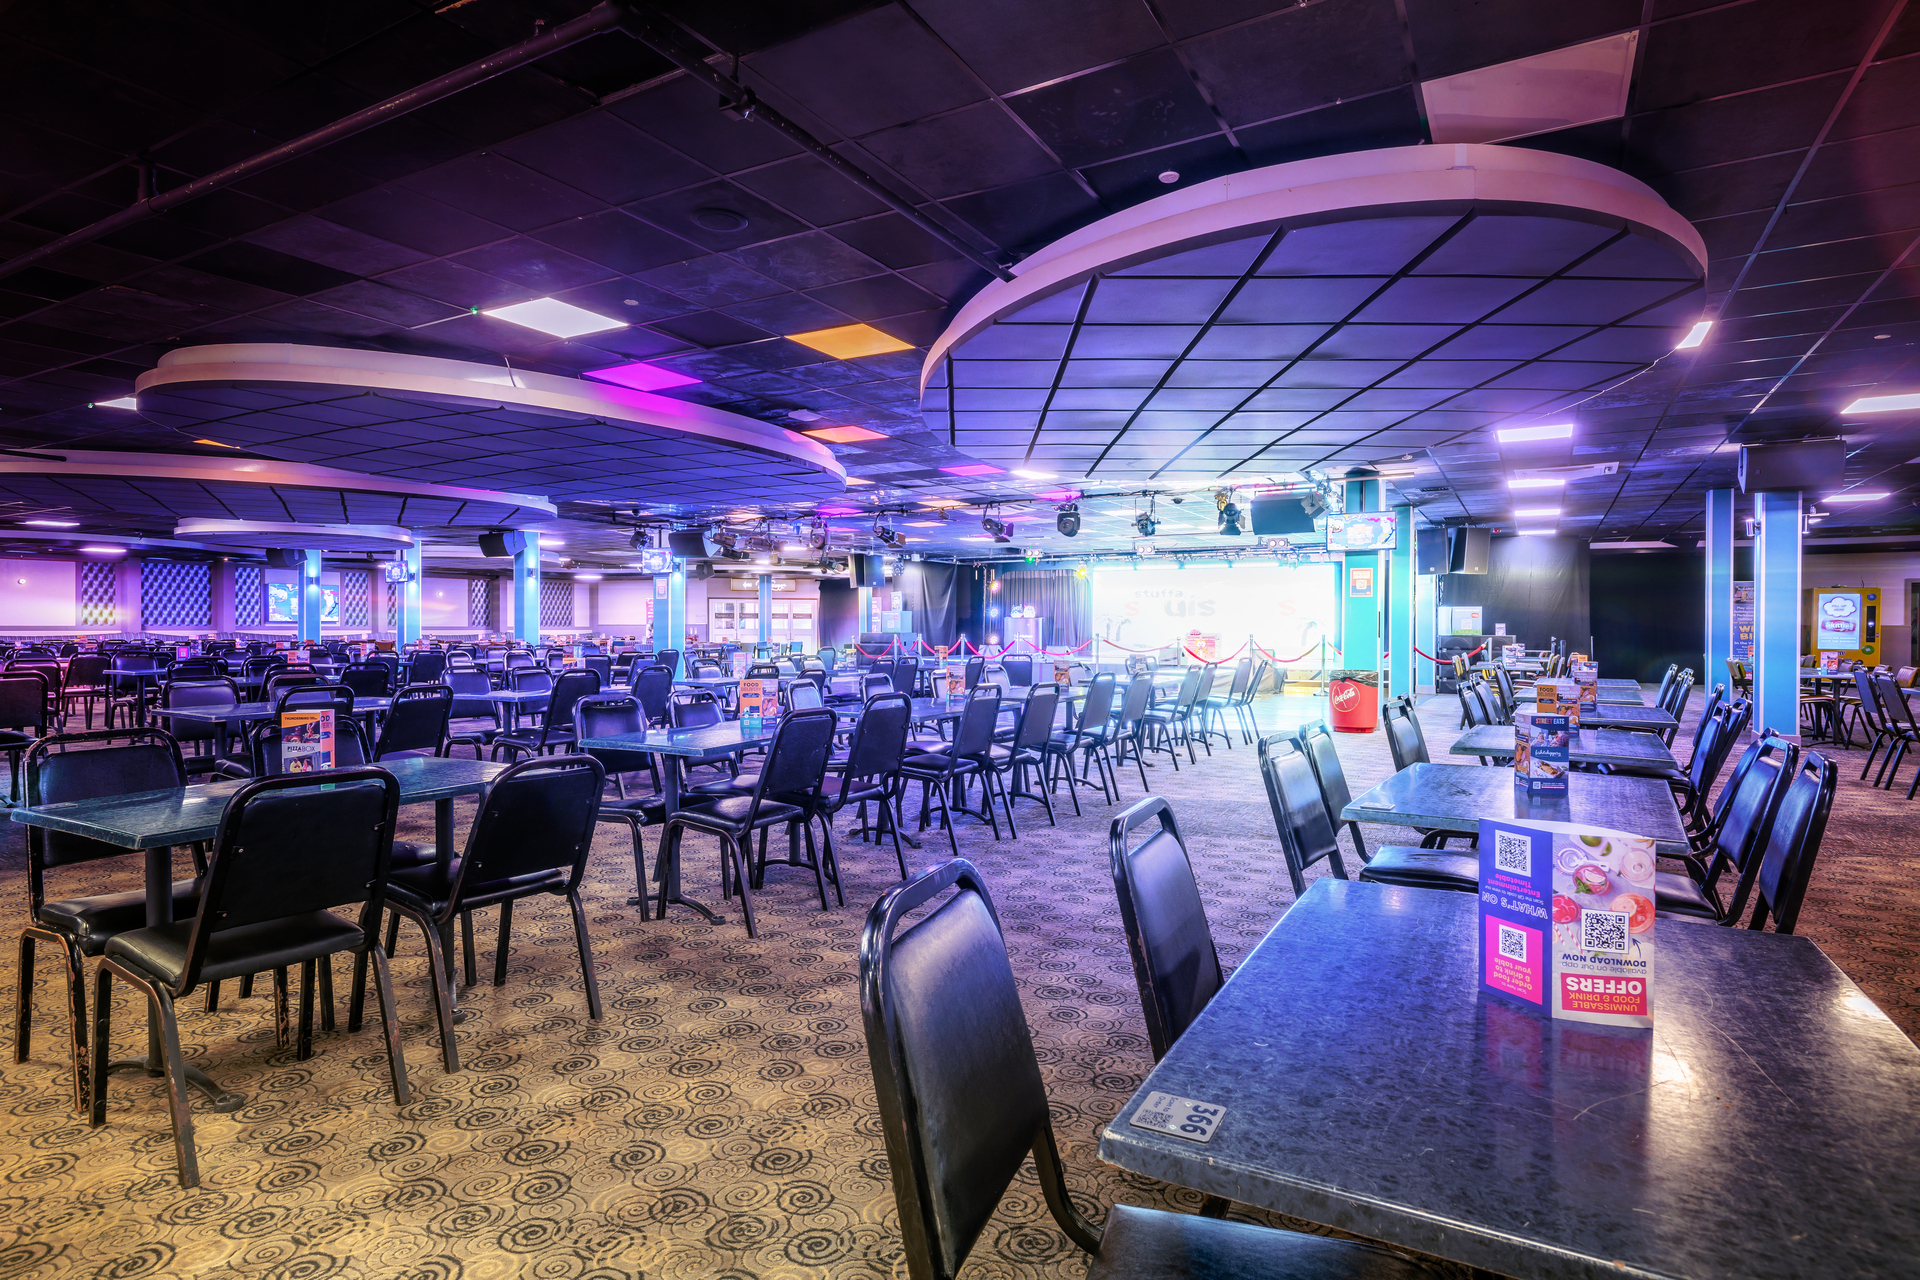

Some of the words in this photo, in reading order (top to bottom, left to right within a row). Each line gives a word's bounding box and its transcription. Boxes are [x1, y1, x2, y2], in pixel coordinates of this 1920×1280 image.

[1495, 873, 1531, 888] Timetable
[1487, 878, 1540, 898] Entertainment
[1482, 891, 1498, 904] ON
[1500, 897, 1548, 919] WHAT'S
[1494, 957, 1513, 968] table
[1562, 953, 1587, 962] NOW
[1590, 956, 1647, 967] DOWNLOAD
[1514, 965, 1532, 974] your
[1562, 961, 1578, 969] app
[1610, 966, 1647, 974] available
[1493, 971, 1510, 982] food
[1504, 968, 1523, 979] drink
[1511, 978, 1532, 990] Order
[1565, 977, 1643, 995] OFFERS
[1569, 992, 1600, 1001] DRINK
[1572, 1000, 1638, 1012] UNMISSABLE
[1153, 1095, 1166, 1108] Order
[1166, 1096, 1179, 1108] Scan
[1180, 1104, 1220, 1136] 366
